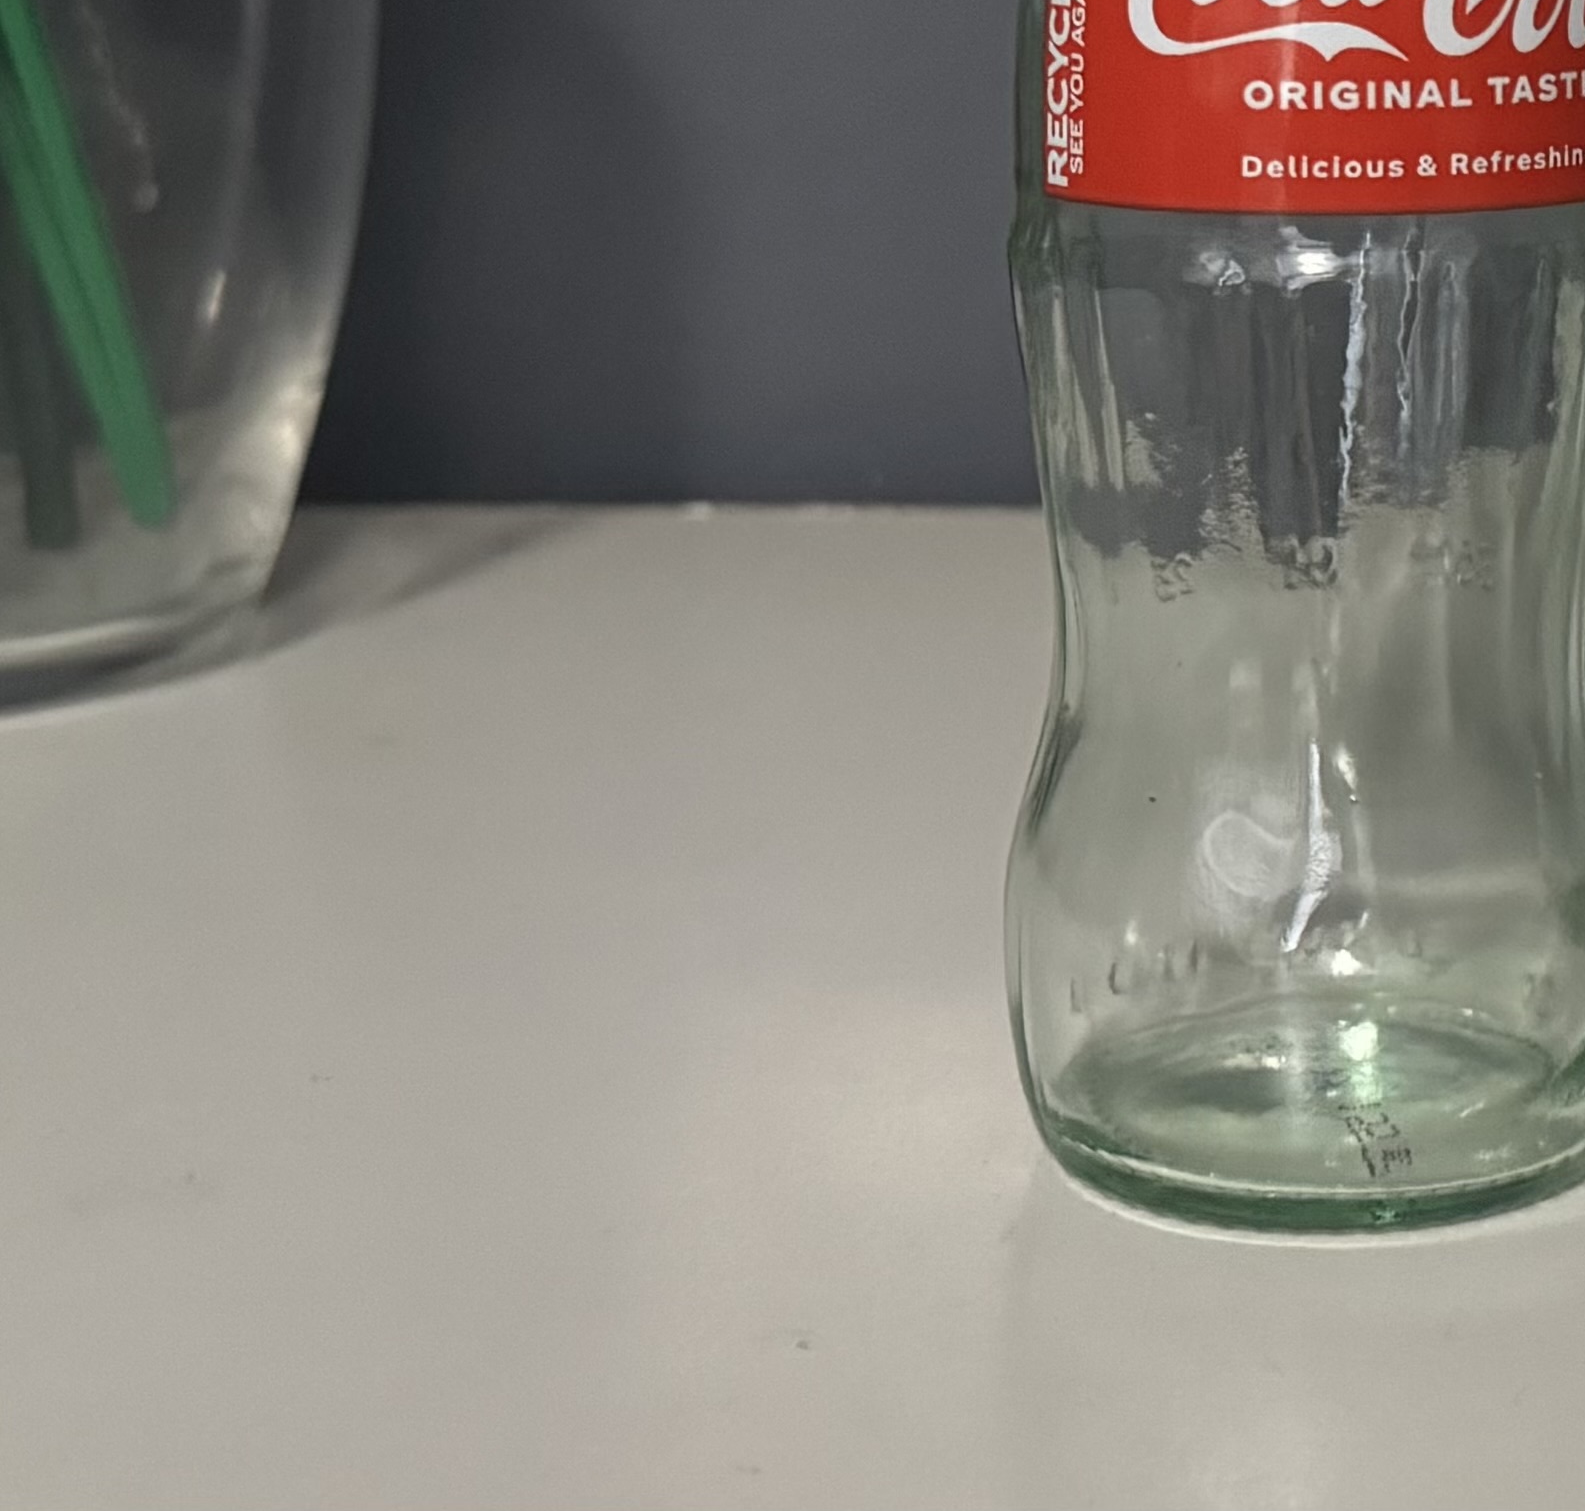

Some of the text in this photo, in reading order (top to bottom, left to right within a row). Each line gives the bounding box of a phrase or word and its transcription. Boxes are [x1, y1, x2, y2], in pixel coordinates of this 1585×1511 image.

[1070, 52, 1085, 112] YOU
[1243, 79, 1473, 111] ORIGINAL
[1069, 119, 1084, 175] SEE
[1241, 155, 1405, 179] Delicious
[1416, 154, 1438, 178] &
